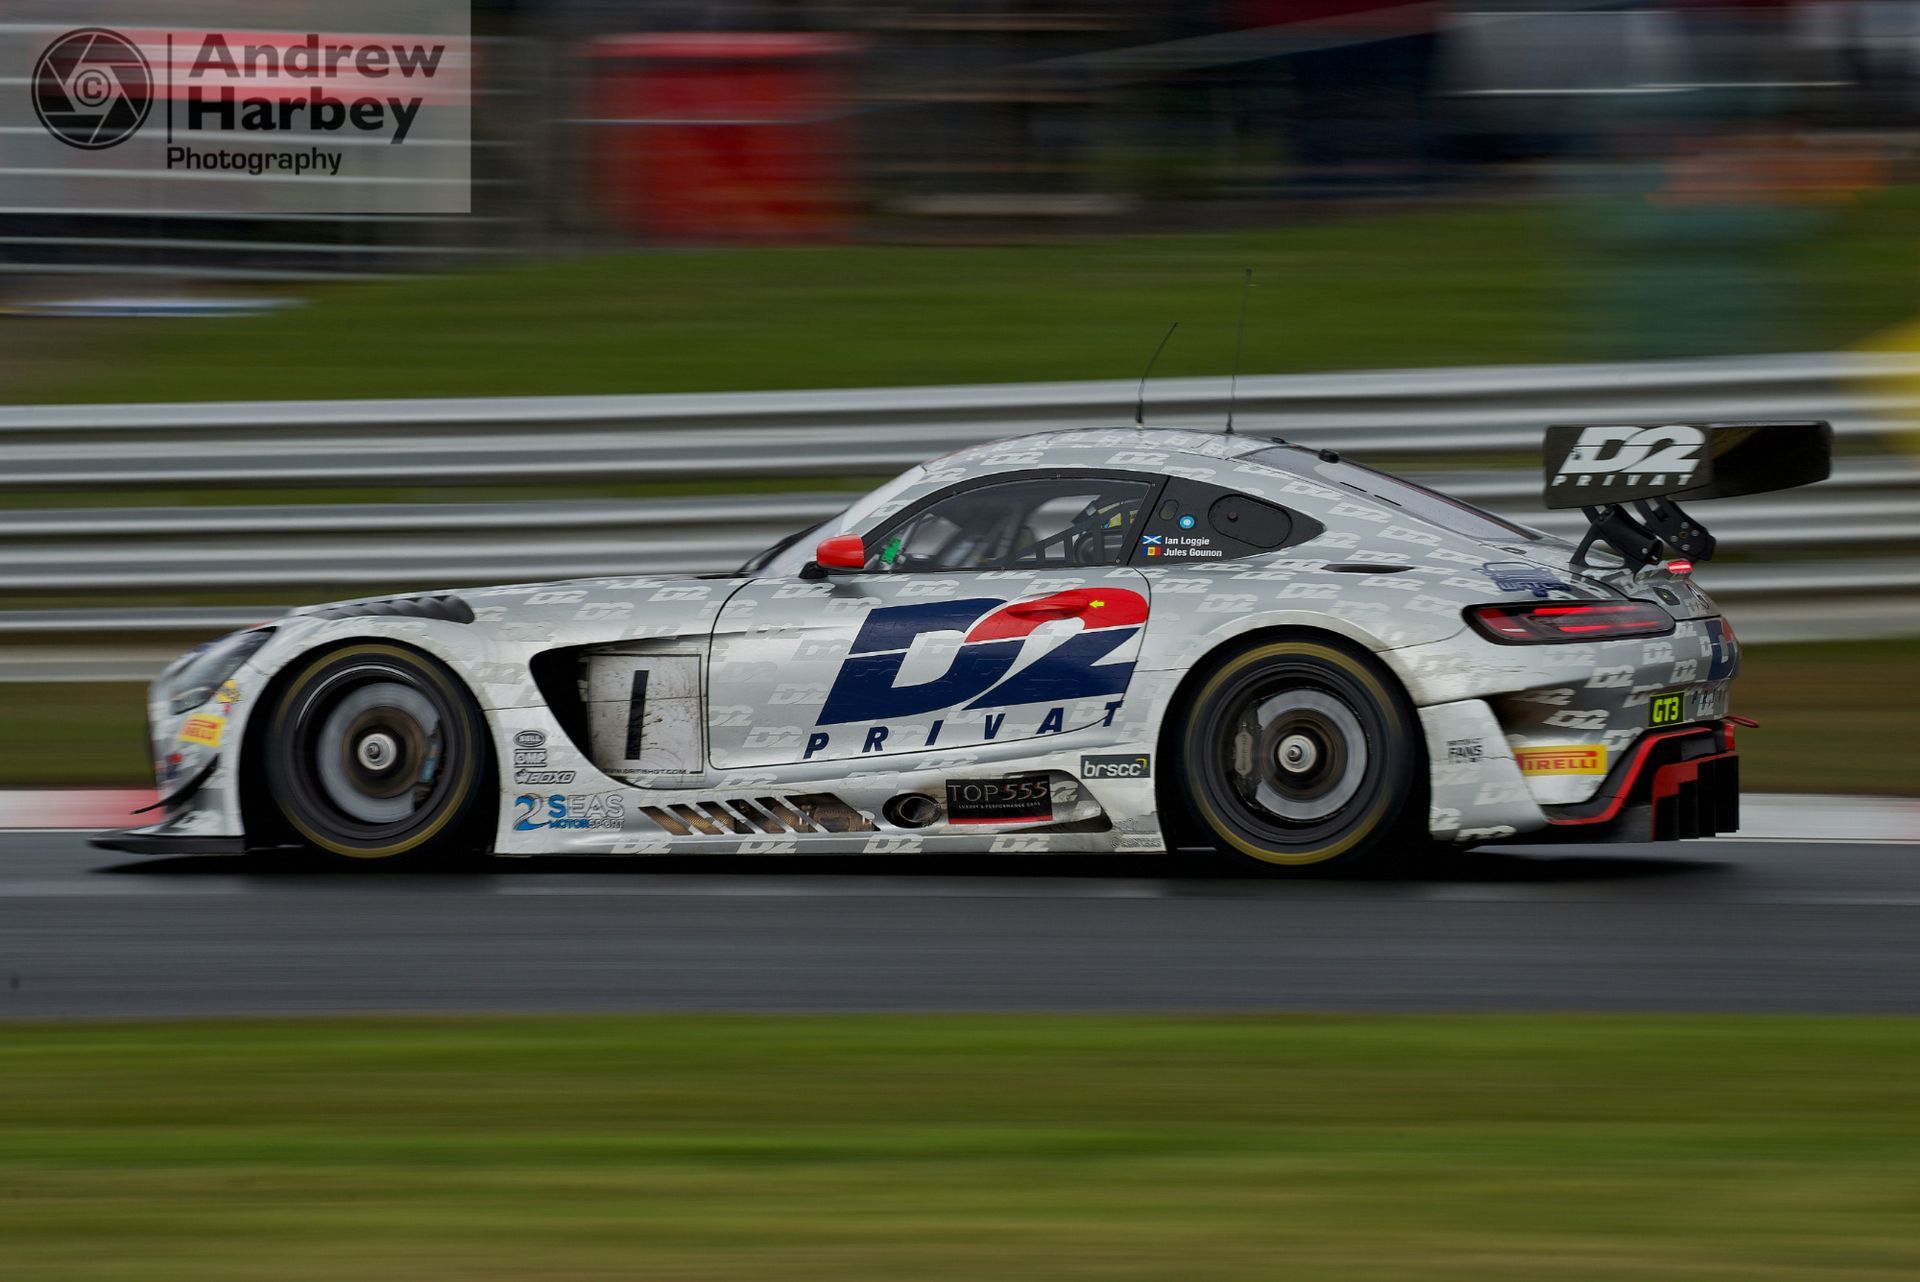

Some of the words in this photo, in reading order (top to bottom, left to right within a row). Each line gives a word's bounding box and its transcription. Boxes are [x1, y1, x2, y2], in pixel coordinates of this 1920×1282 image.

[1104, 451, 1170, 466] D2
[1558, 425, 1706, 474] D2
[1551, 474, 1693, 486] PRIVAT
[1328, 502, 1393, 524] D2
[1165, 536, 1178, 545] Ian
[1181, 536, 1210, 547] Loggie
[1163, 548, 1187, 557] Jules
[1189, 548, 1222, 557] Gounon
[648, 586, 712, 602] D2
[771, 583, 836, 599] D2
[896, 579, 960, 597] D2
[1276, 583, 1343, 599] D2
[523, 590, 589, 605] D2
[1195, 594, 1258, 613] D2
[815, 587, 1150, 726] D2
[1642, 642, 1676, 665] D2
[1585, 665, 1635, 688] D2
[1668, 659, 1698, 683] D2
[1653, 696, 1679, 723] GT3
[1543, 709, 1610, 730] D2
[742, 726, 803, 749] D2
[803, 700, 1123, 760] PRIVAT
[526, 771, 576, 784] BOXO
[1083, 760, 1142, 778] brscc
[548, 794, 625, 818] SEAS
[548, 819, 625, 829] MOTORSPORT
[862, 833, 923, 853] D2
[988, 835, 1049, 853] D2
